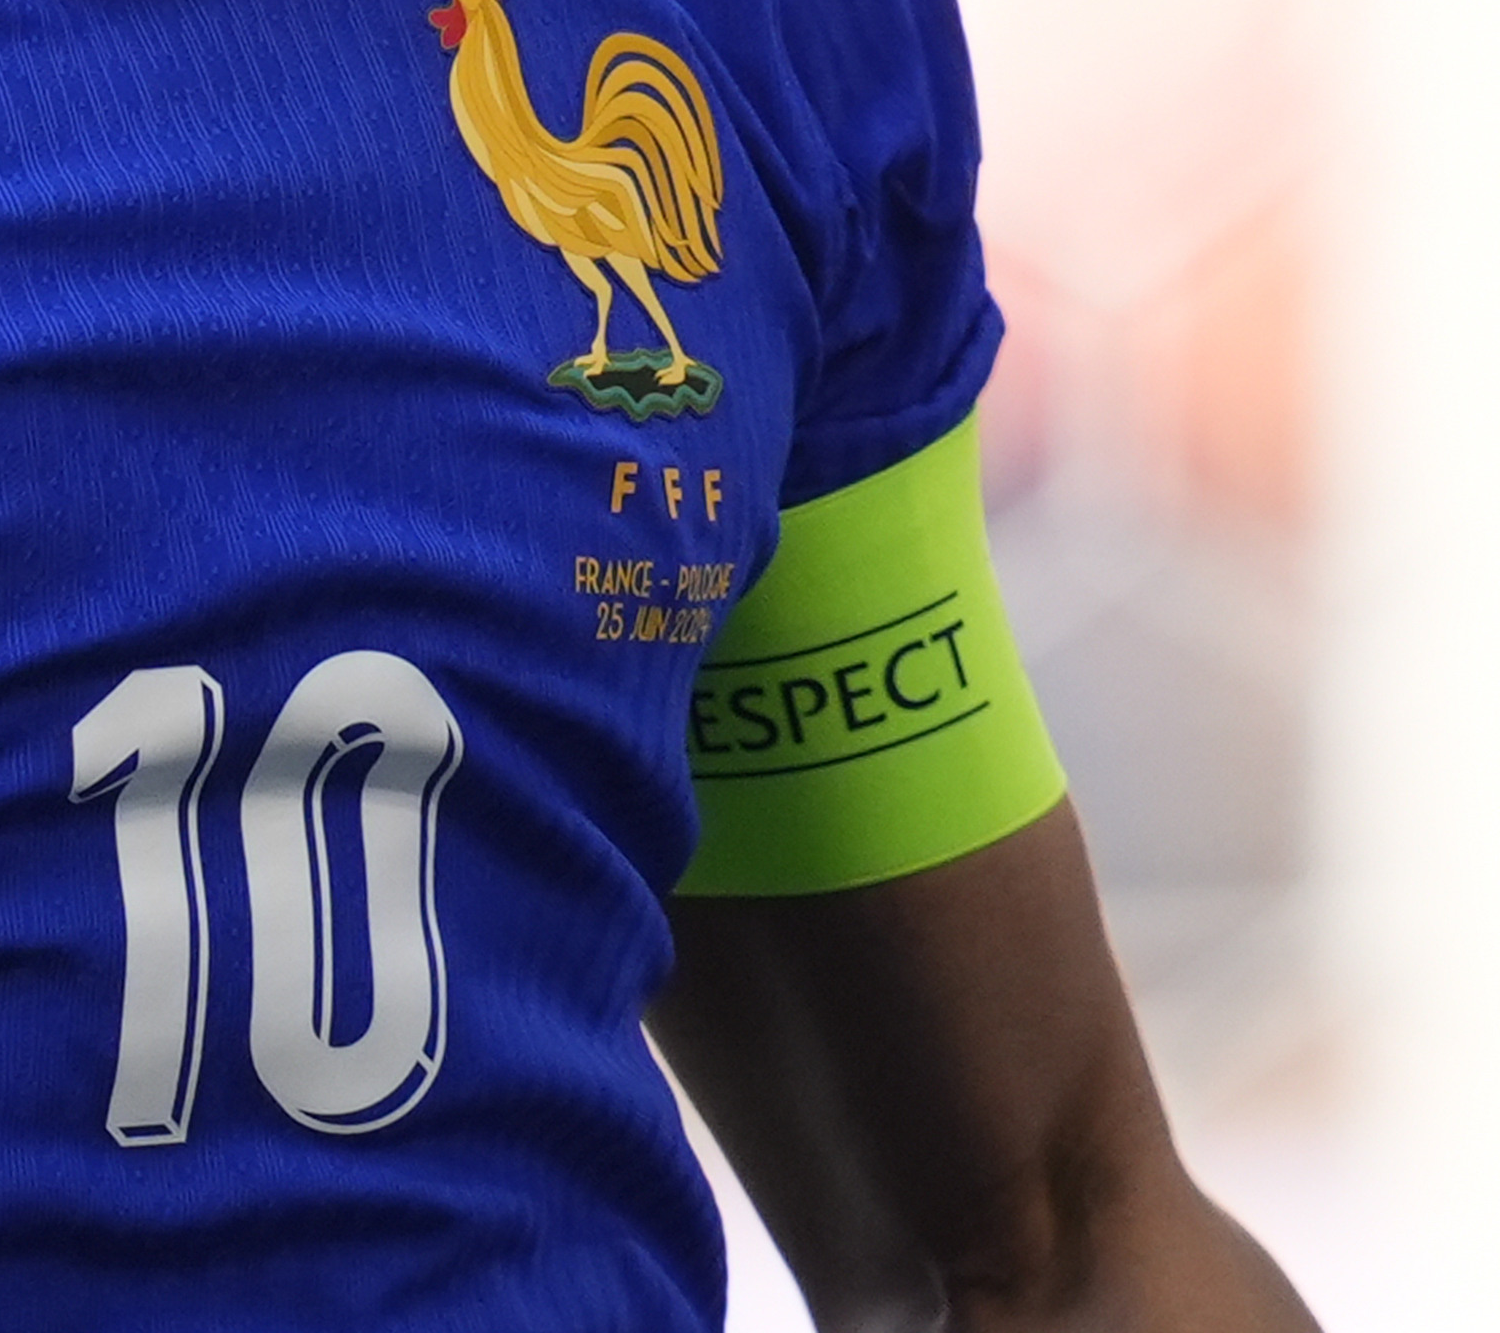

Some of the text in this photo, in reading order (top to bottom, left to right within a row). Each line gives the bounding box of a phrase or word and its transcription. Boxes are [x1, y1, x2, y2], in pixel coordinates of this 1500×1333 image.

[575, 556, 654, 598] FRANCE
[596, 601, 624, 641] 25
[690, 620, 968, 753] ESPECT
[69, 650, 464, 1147] 10
